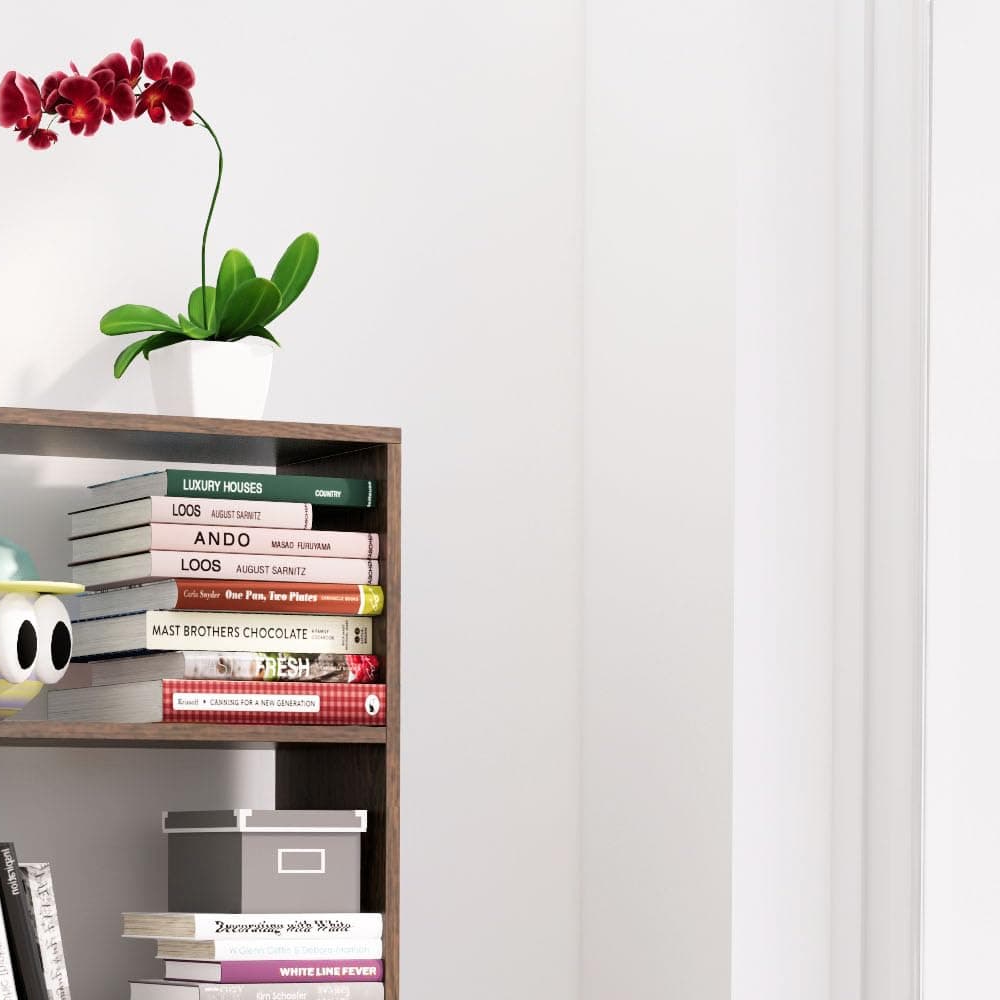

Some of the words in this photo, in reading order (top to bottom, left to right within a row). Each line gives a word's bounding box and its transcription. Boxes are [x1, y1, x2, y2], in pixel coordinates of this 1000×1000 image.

[183, 479, 221, 492] LUXURY
[223, 480, 263, 494] HOUSES
[315, 489, 341, 498] COUNTRY
[172, 503, 201, 517] LOOS
[211, 509, 235, 519] AUGUST
[236, 510, 261, 520] SARNITZ
[194, 531, 250, 547] ANDO
[297, 541, 331, 550] FURUYAMA
[181, 558, 221, 572] LOOS
[236, 565, 269, 575] AUGUST
[272, 566, 306, 576] SARNITZ
[225, 590, 243, 600] One
[269, 591, 287, 601] Two
[289, 591, 317, 602] Plates
[152, 625, 180, 637] MAST
[184, 625, 240, 638] BROTHERS
[243, 626, 308, 640] CHOCOLATE
[256, 657, 310, 678] FRESH
[276, 700, 316, 708] GENERATION
[215, 920, 285, 937] Decorating
[286, 920, 312, 933] with
[279, 967, 315, 976] WHITE
[316, 967, 340, 976] LINE
[342, 966, 377, 976] FEVER
